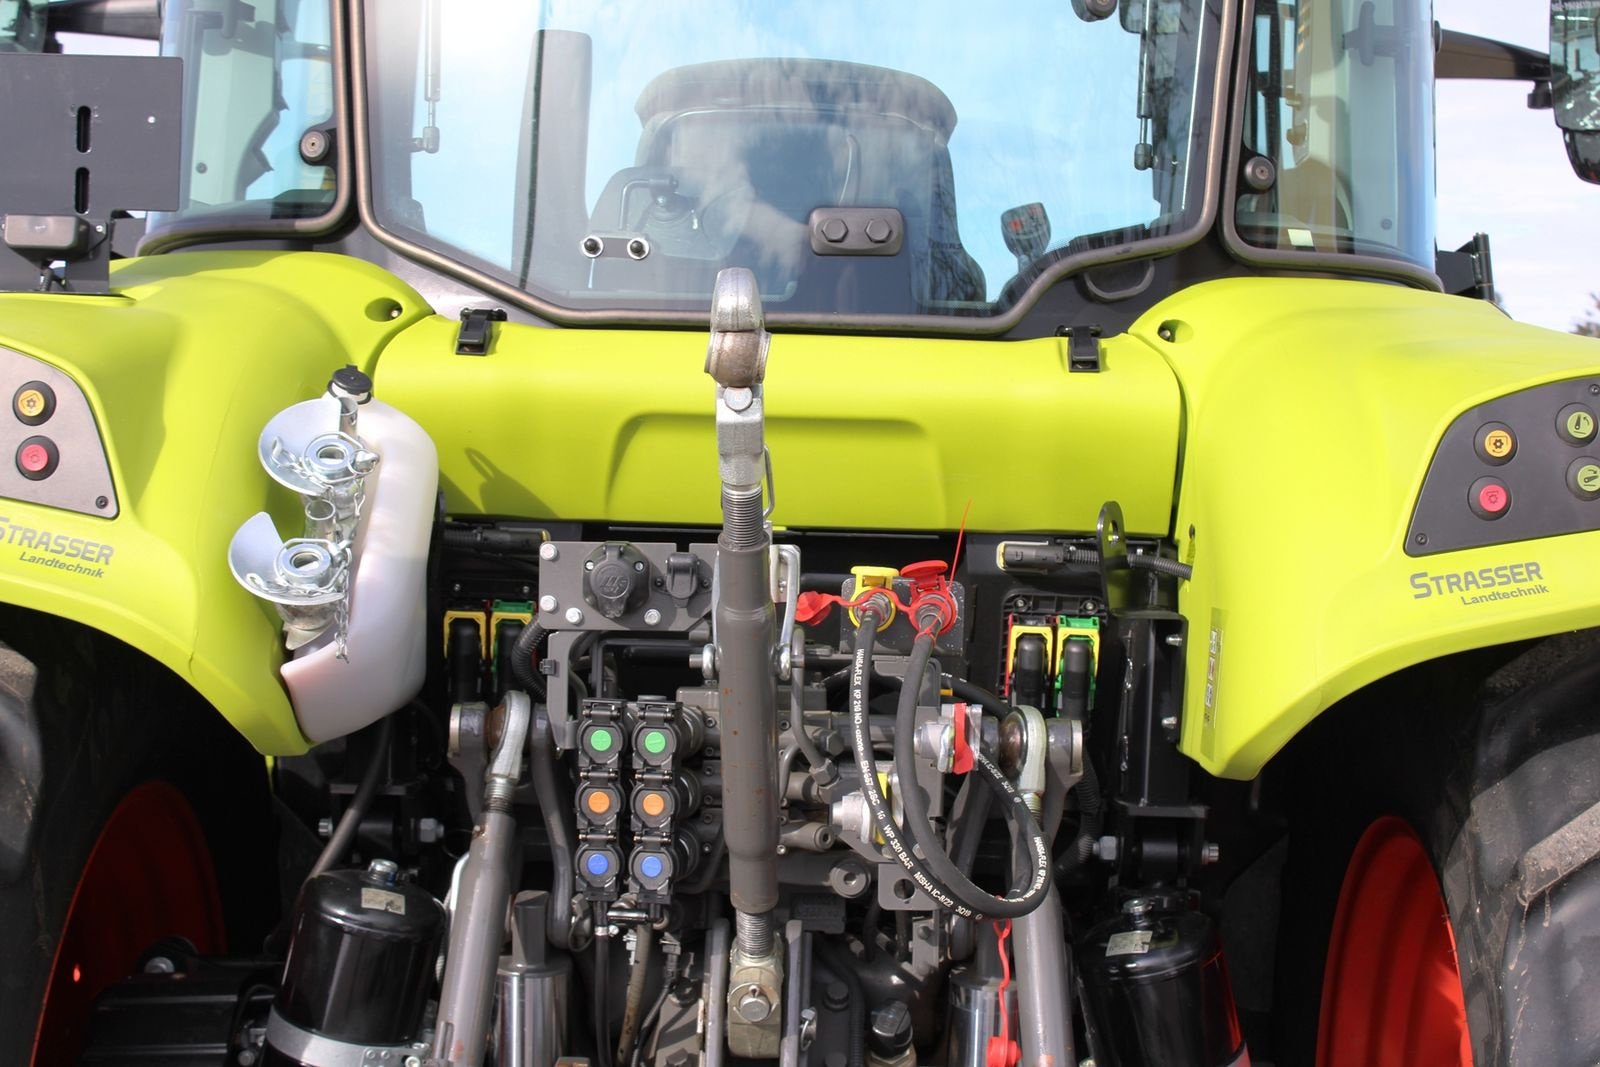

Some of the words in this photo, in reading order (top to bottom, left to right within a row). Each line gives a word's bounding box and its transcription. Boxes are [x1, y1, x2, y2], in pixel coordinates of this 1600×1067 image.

[19, 551, 104, 578] Landtechnik
[1460, 584, 1549, 605] Landtechnik
[883, 824, 896, 839] WP
[898, 851, 915, 870] BAR
[913, 871, 933, 893] MSHA
